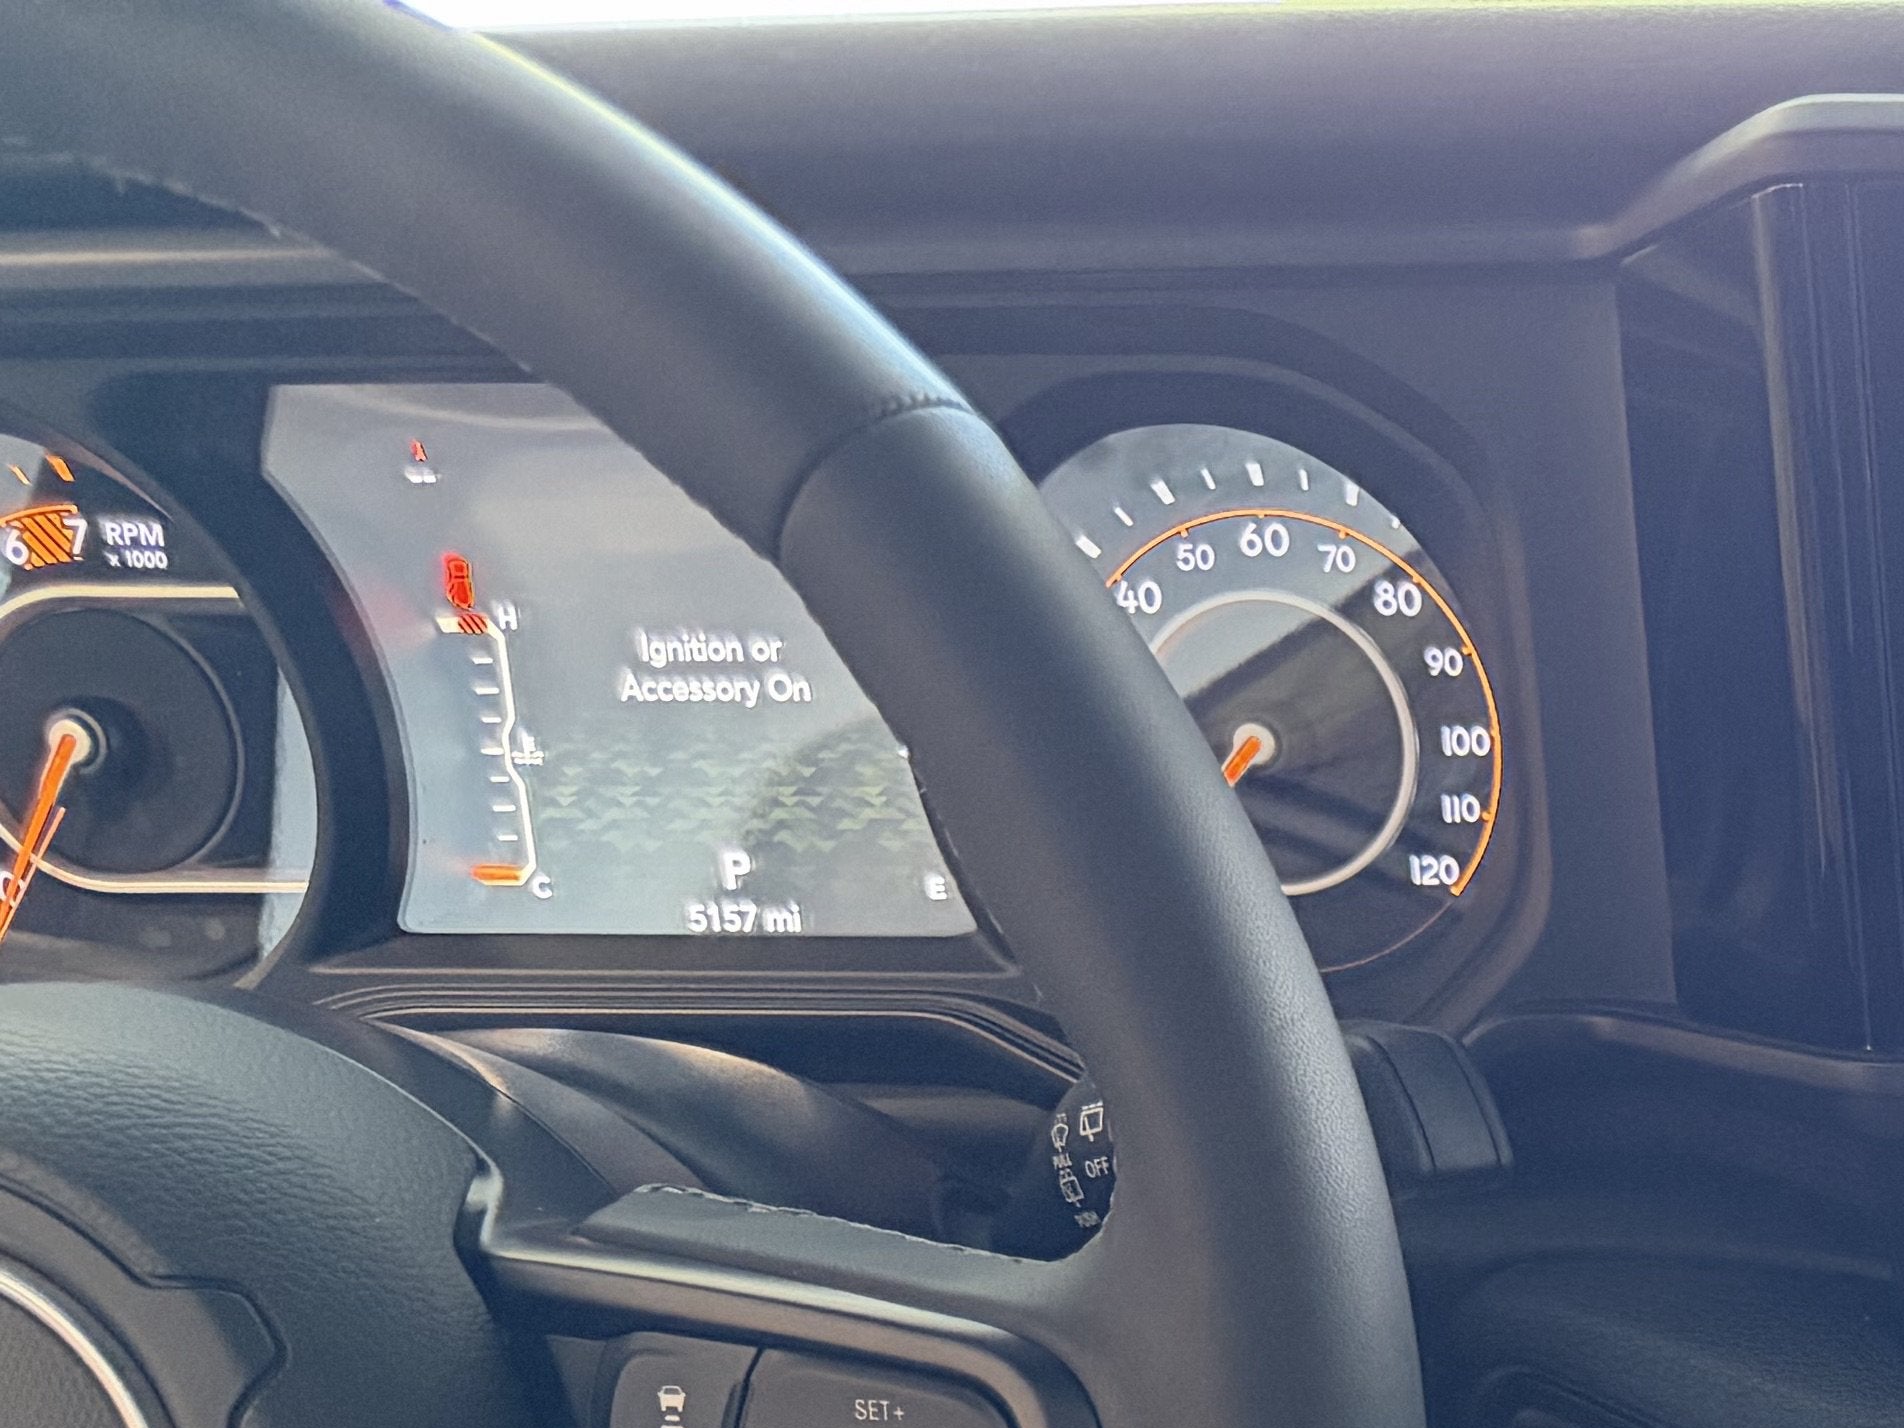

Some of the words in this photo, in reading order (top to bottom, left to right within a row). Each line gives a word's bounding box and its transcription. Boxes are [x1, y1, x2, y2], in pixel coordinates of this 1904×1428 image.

[5, 529, 29, 567] 6
[104, 521, 166, 549] RPM
[1240, 522, 1290, 557] 60
[125, 550, 168, 569] 1000
[1176, 543, 1215, 572] 50
[1317, 544, 1356, 573] 70
[1116, 580, 1162, 614] 40
[1373, 581, 1422, 618] 80
[499, 605, 518, 631] H
[640, 632, 744, 668] Ignition
[751, 640, 784, 662] or
[1423, 646, 1464, 677] 90
[621, 670, 760, 708] Accessory
[767, 673, 812, 702] On
[1440, 726, 1491, 757] 100
[1440, 794, 1481, 824] 110
[723, 850, 751, 890] P
[1409, 855, 1460, 886] 120
[532, 875, 553, 900] C
[925, 875, 947, 901] E
[687, 902, 757, 933] 5157
[765, 903, 803, 933] mi
[1084, 1156, 1109, 1178] OFF
